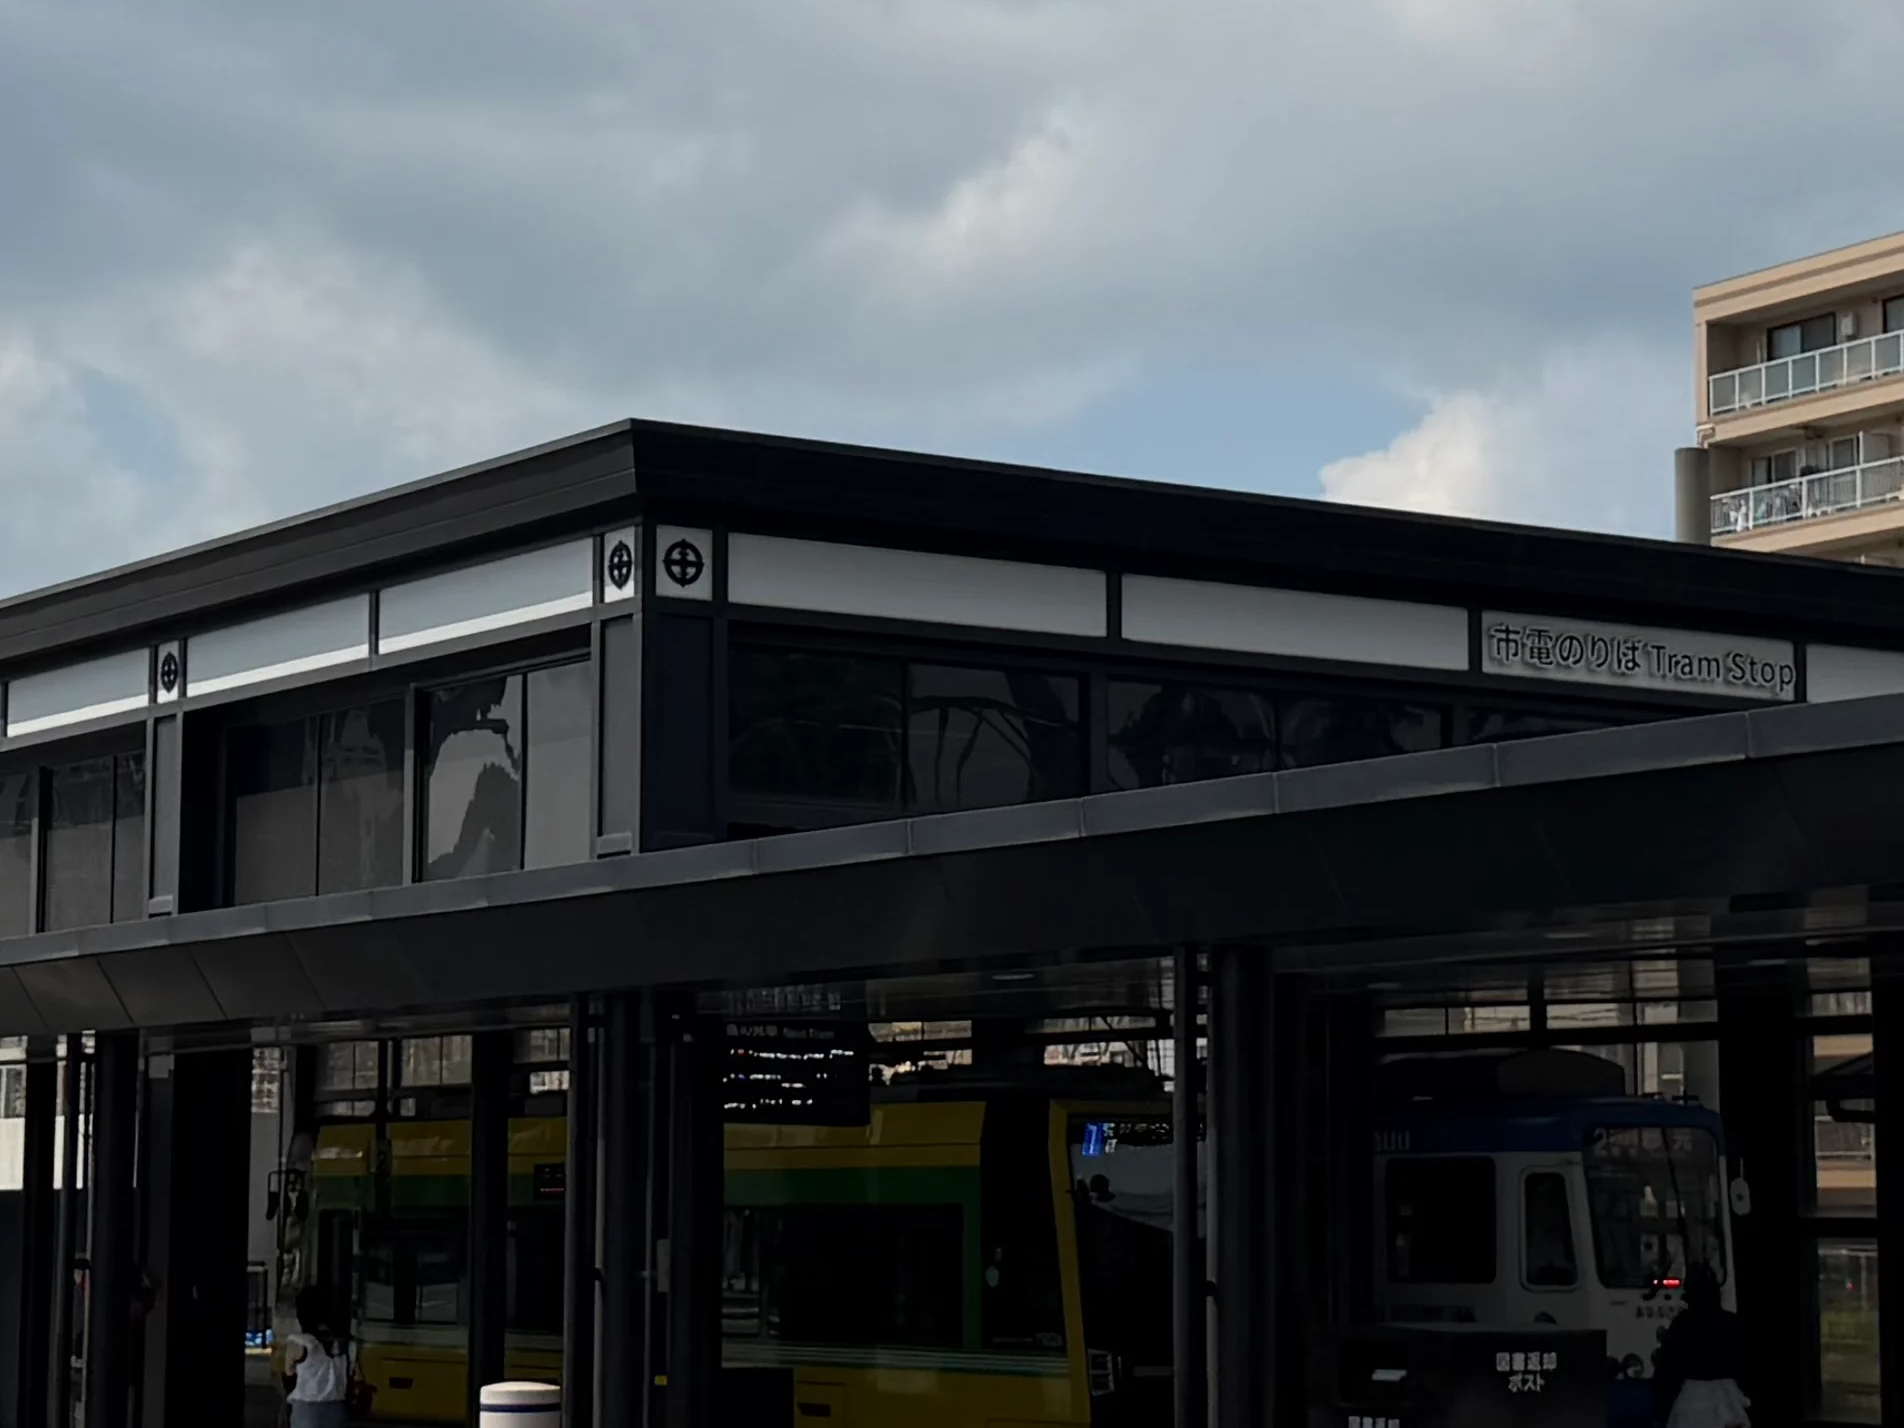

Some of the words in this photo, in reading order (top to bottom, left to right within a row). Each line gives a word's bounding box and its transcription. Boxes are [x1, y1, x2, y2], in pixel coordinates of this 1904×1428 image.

[1492, 624, 1642, 672] 市電のりば
[1650, 644, 1721, 679] Tram
[1731, 652, 1795, 693] Stop
[1508, 1373, 1545, 1393] ポスト
